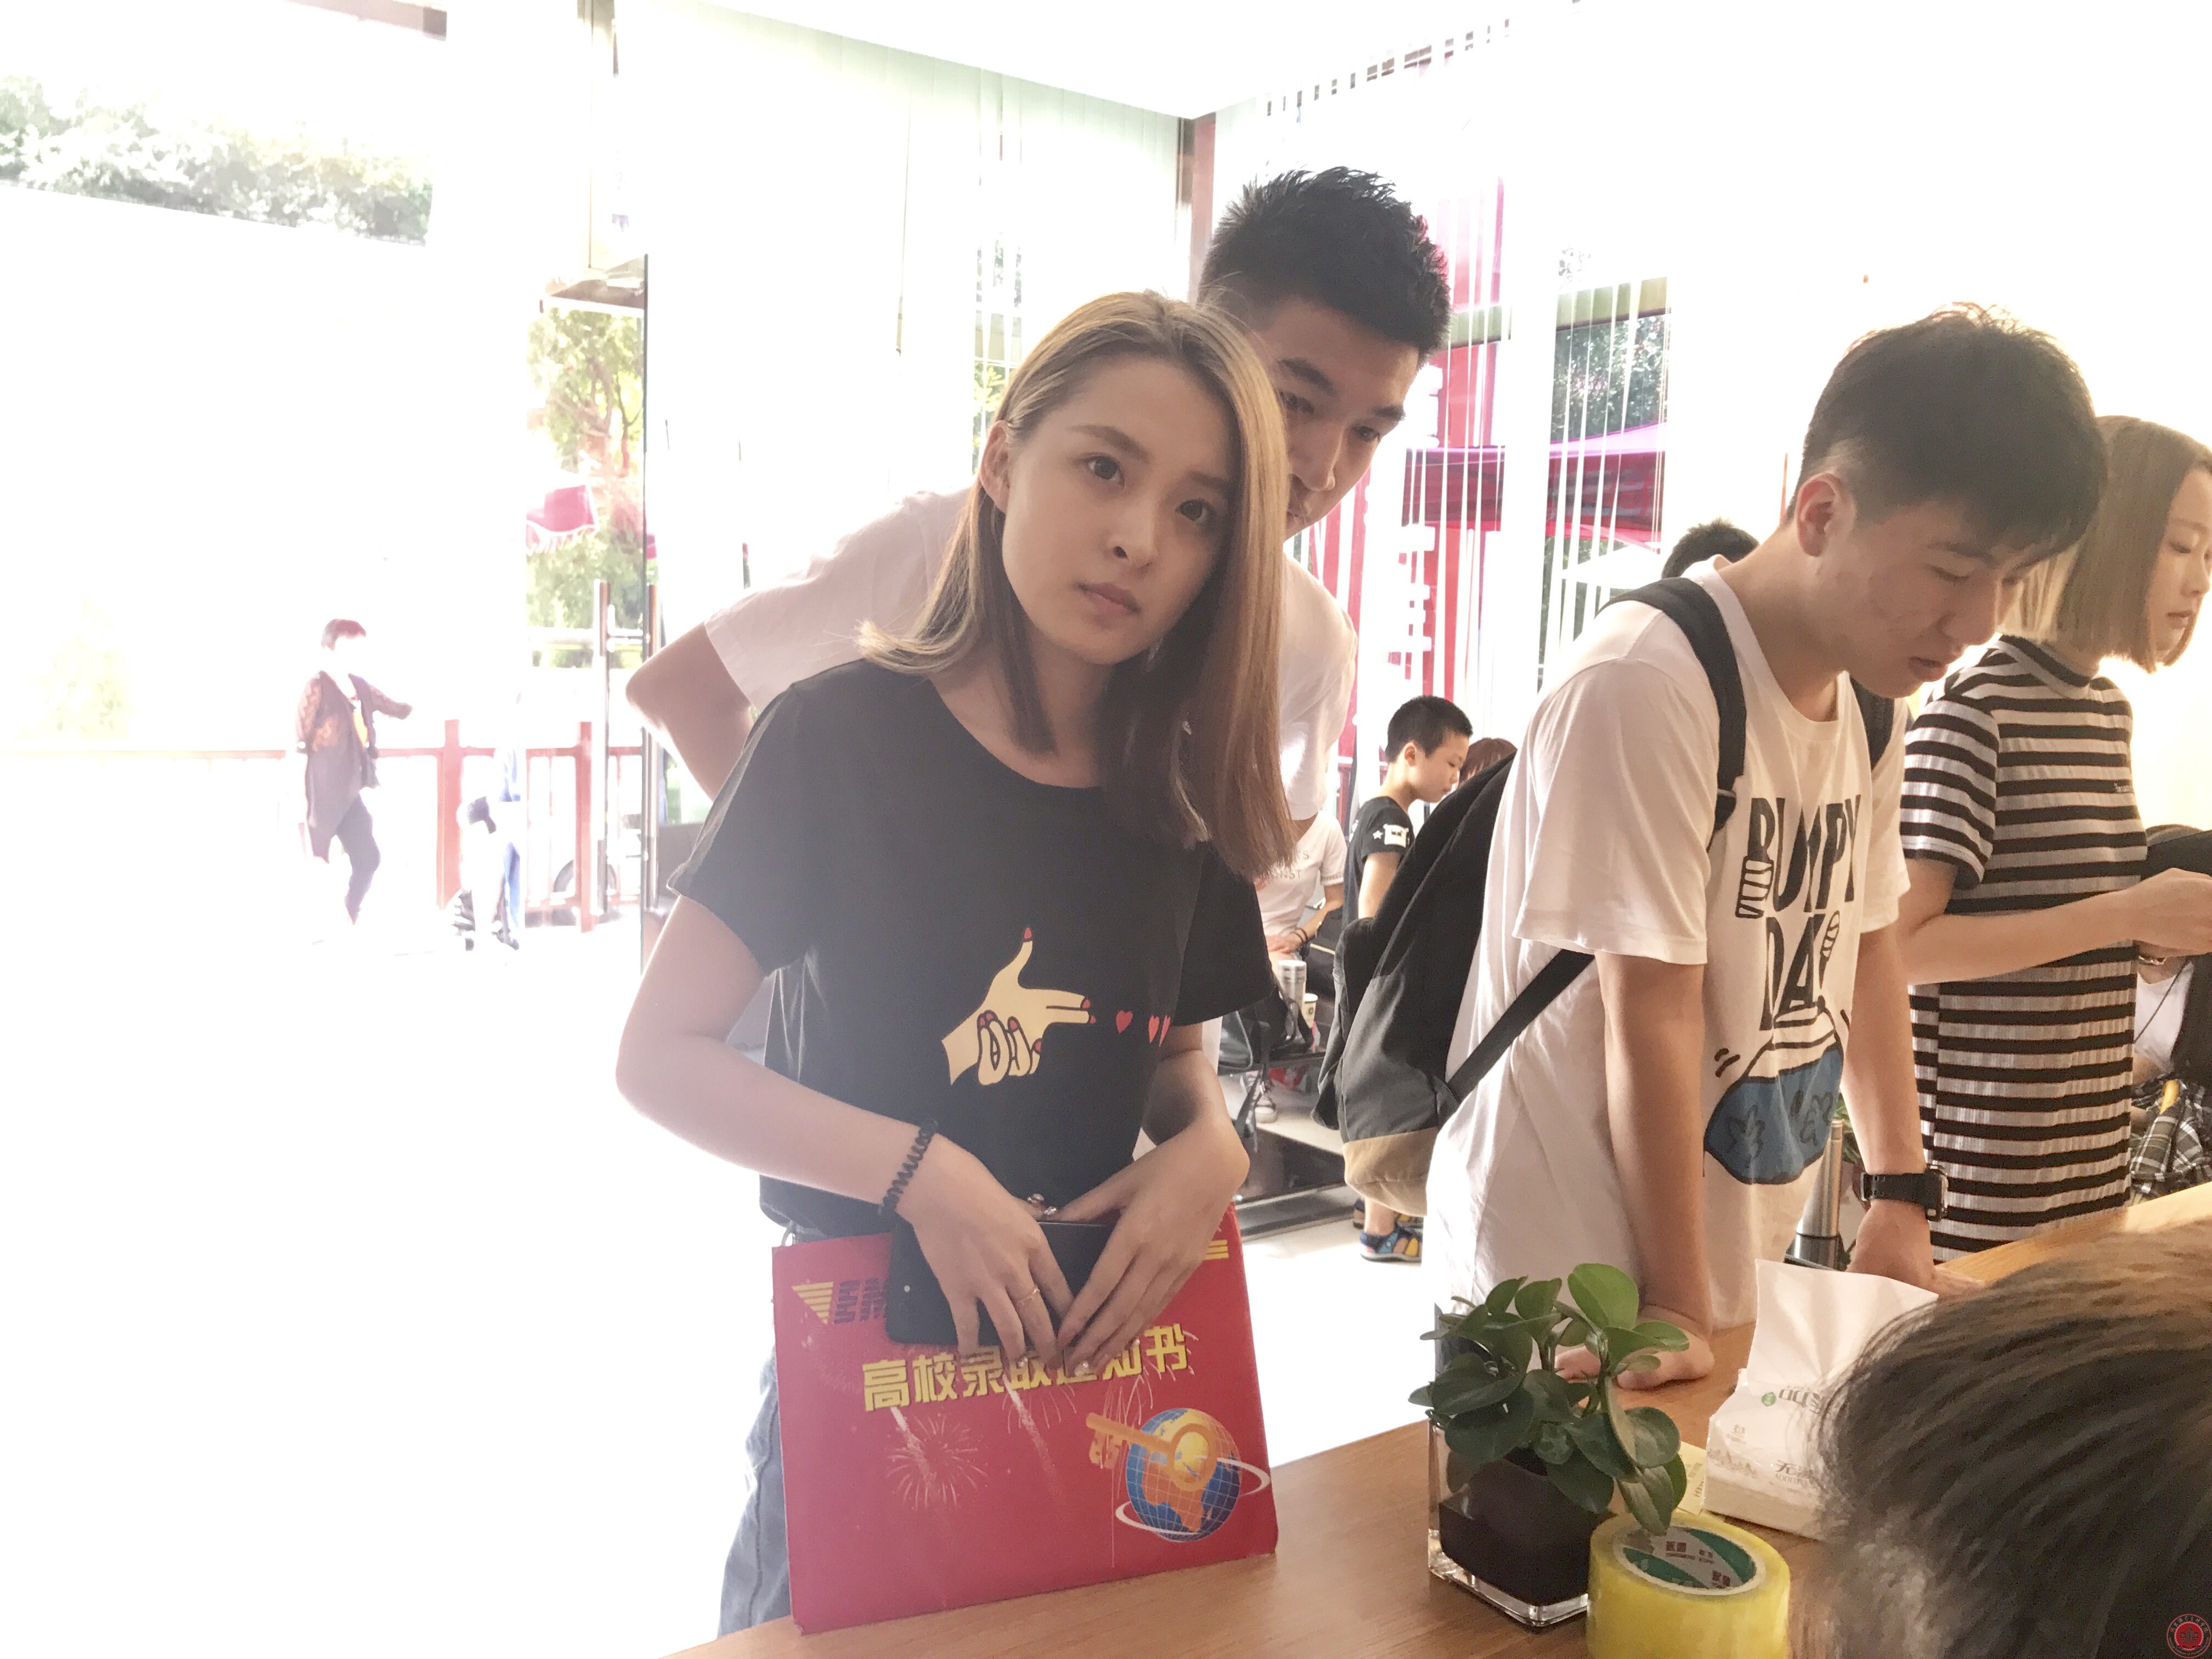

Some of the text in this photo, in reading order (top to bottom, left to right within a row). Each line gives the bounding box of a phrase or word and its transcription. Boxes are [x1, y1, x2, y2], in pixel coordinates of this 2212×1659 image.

[862, 1323, 1187, 1412] 高校录取知书
